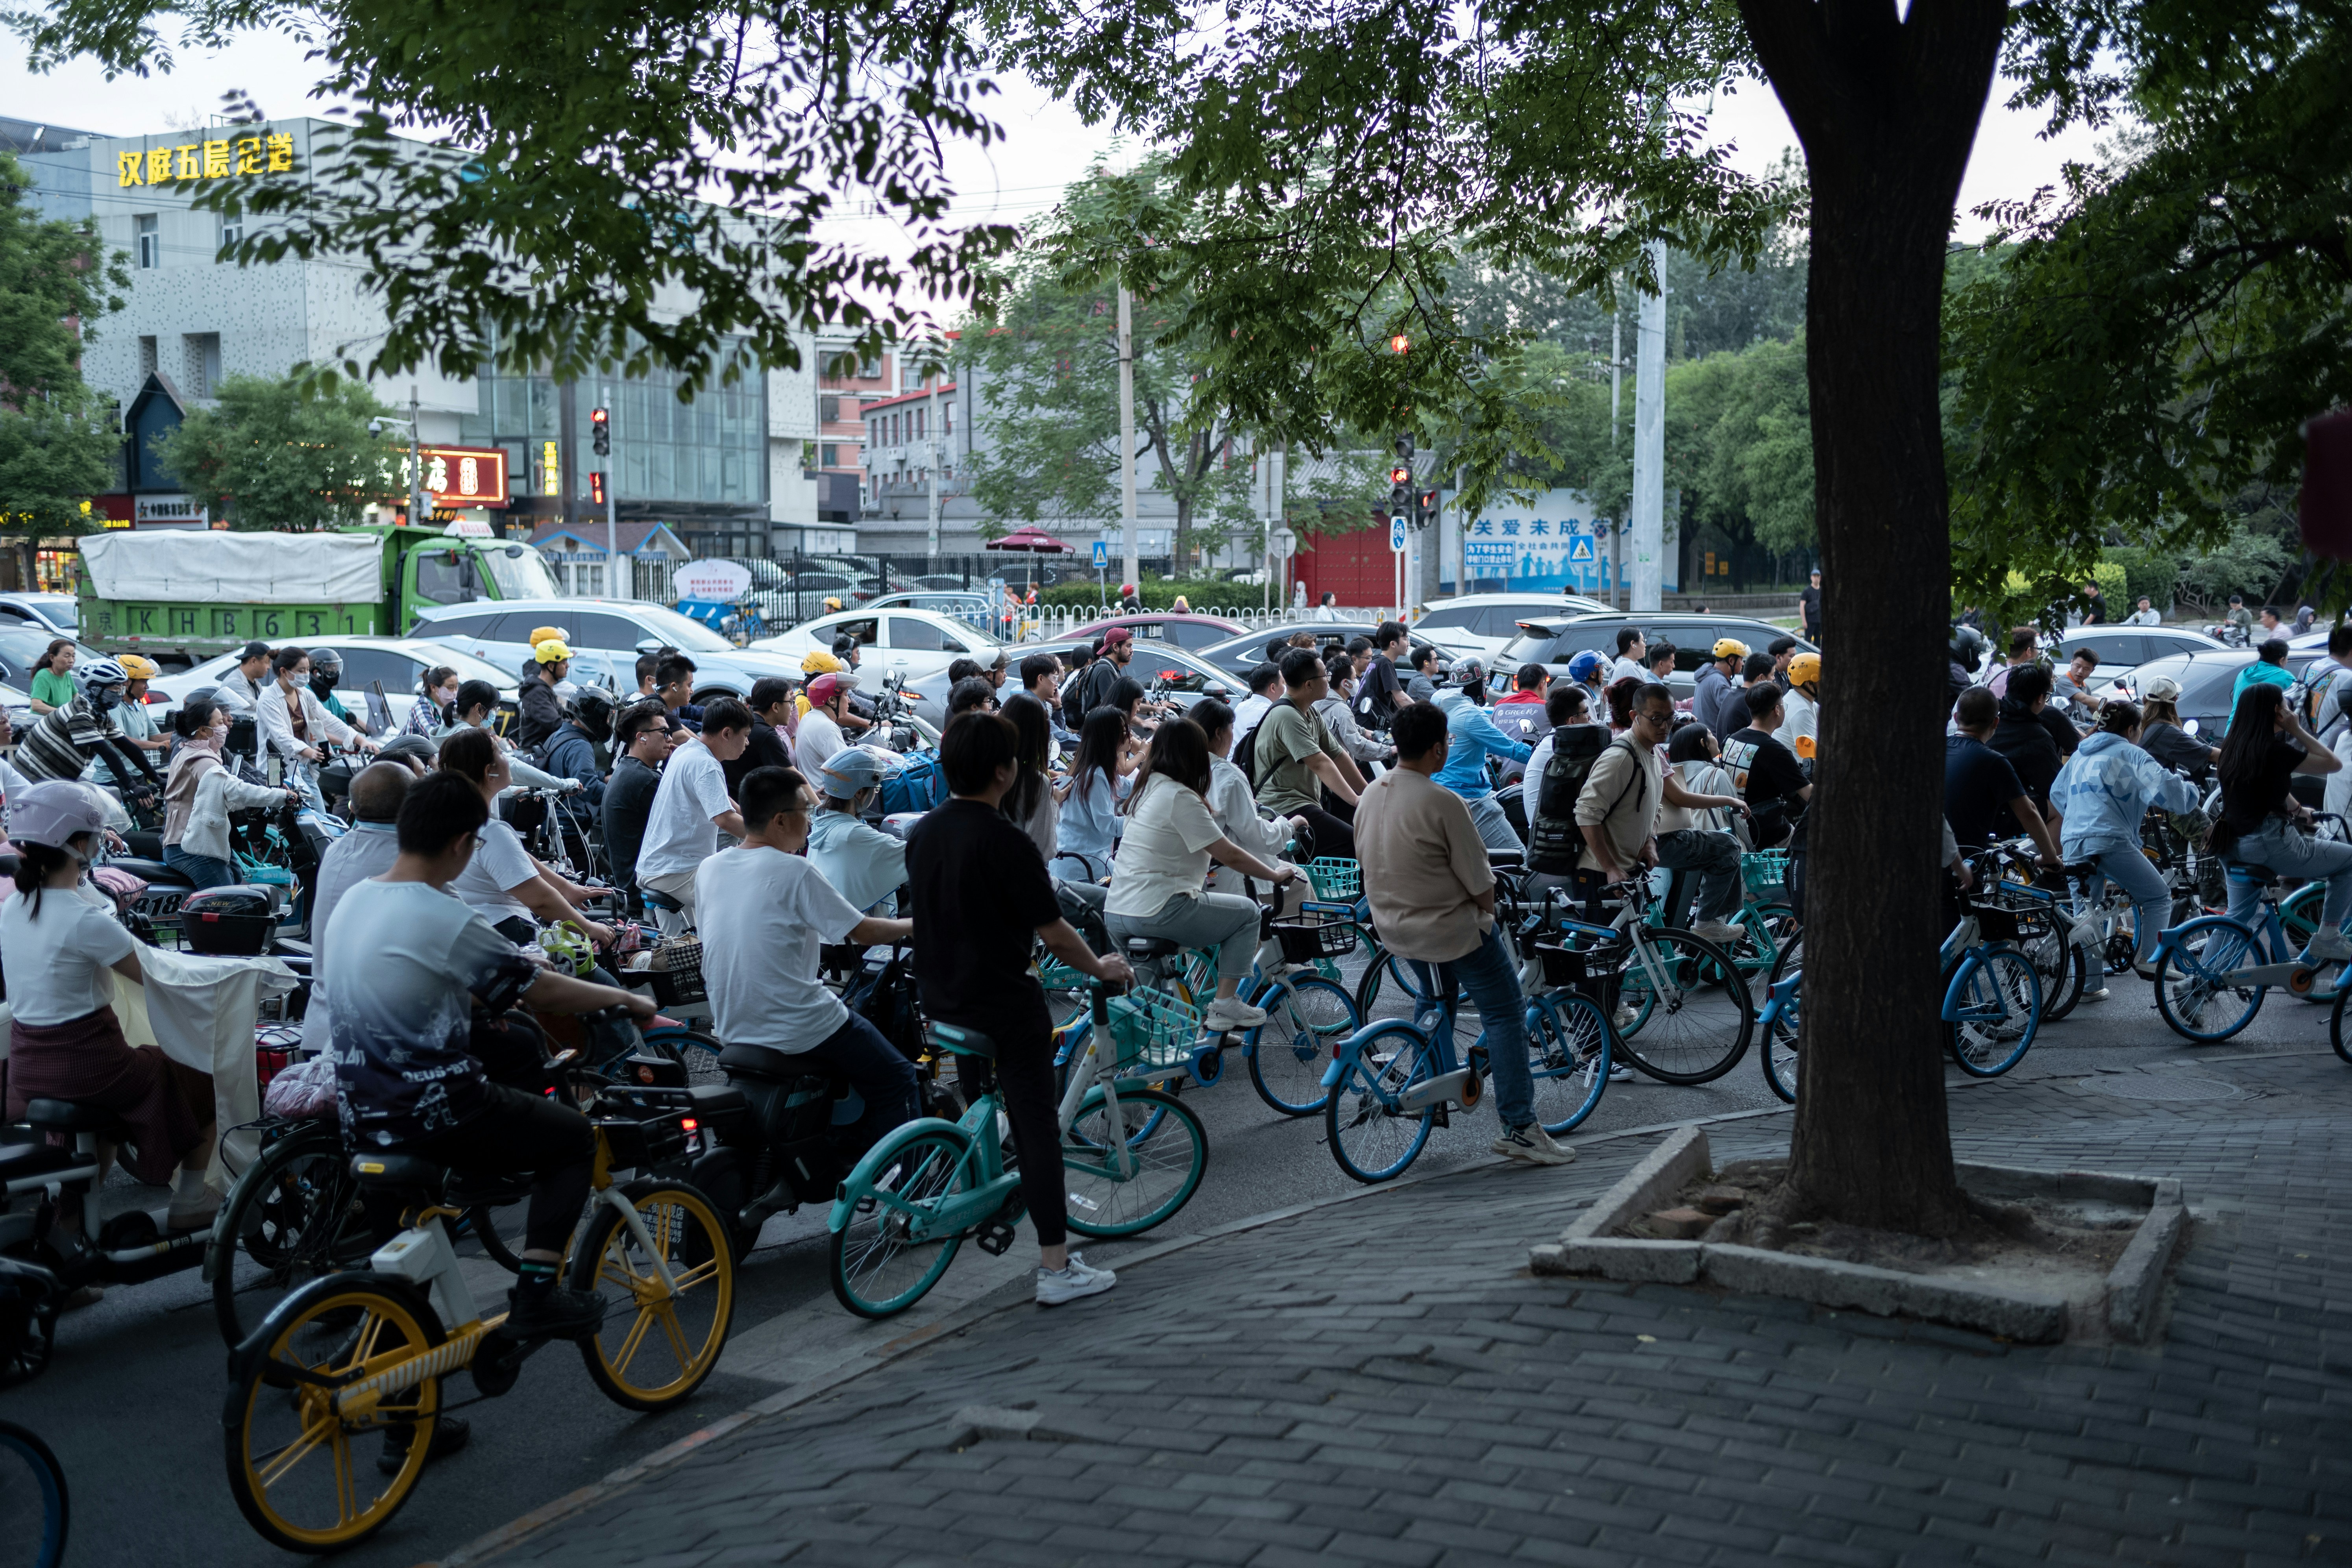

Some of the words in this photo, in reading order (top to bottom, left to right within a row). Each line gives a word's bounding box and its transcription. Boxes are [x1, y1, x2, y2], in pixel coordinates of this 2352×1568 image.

[118, 132, 293, 187] 汉庭五层足道
[1467, 544, 1512, 554] 为了学生安全
[1467, 555, 1512, 564] 学校门口禁止停车
